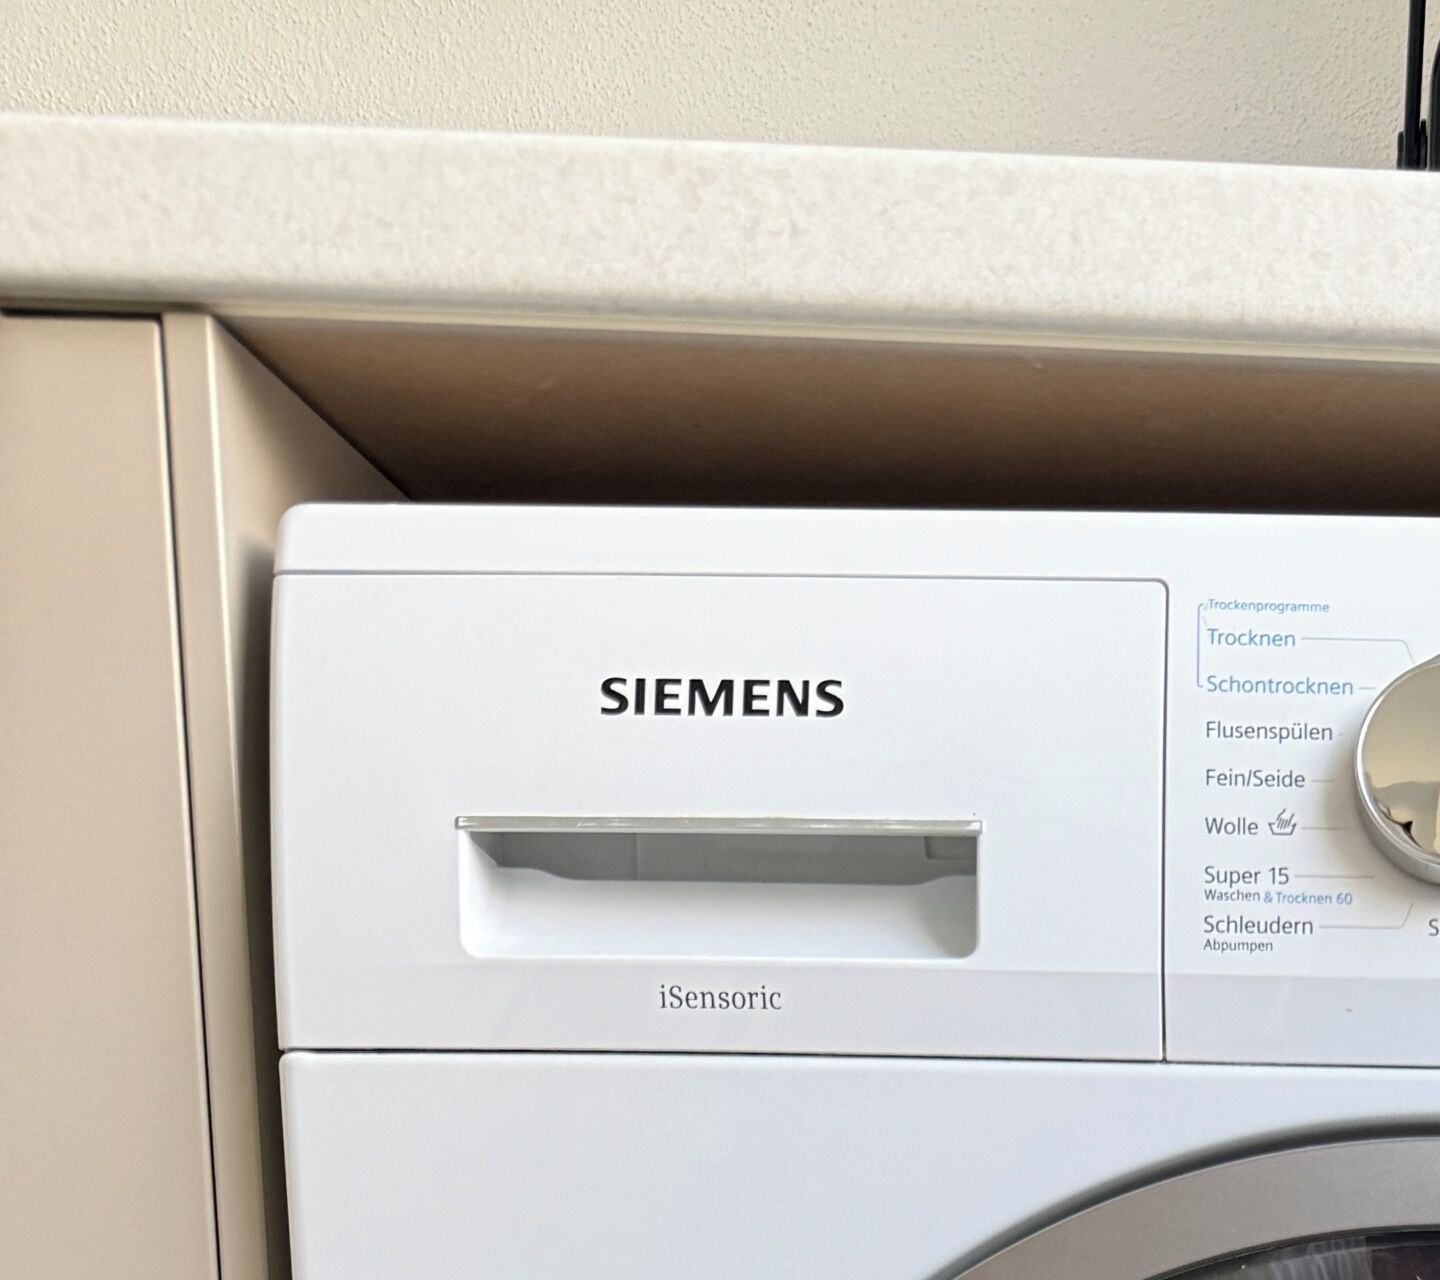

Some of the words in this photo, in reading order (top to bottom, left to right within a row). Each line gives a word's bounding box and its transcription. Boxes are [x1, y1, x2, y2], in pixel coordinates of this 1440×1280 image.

[1207, 599, 1330, 614] Trockenprogramme
[1207, 628, 1296, 647] Trocknen
[1207, 675, 1354, 695] Schontrocknen
[600, 677, 845, 718] SIEMENS
[1206, 721, 1333, 744] Flusenspülen
[1205, 769, 1305, 788] Fein/Seide
[1205, 817, 1259, 836] Wolle
[1204, 866, 1261, 888] Super
[1269, 867, 1290, 885] 15
[1204, 889, 1261, 902] Waschen
[1264, 892, 1273, 903] &
[1275, 892, 1332, 905] Trocknen
[1337, 893, 1353, 905] 60
[1204, 915, 1313, 935] Schleudern
[1203, 939, 1273, 954] Abpumpen
[659, 984, 783, 1011] iSensoric
